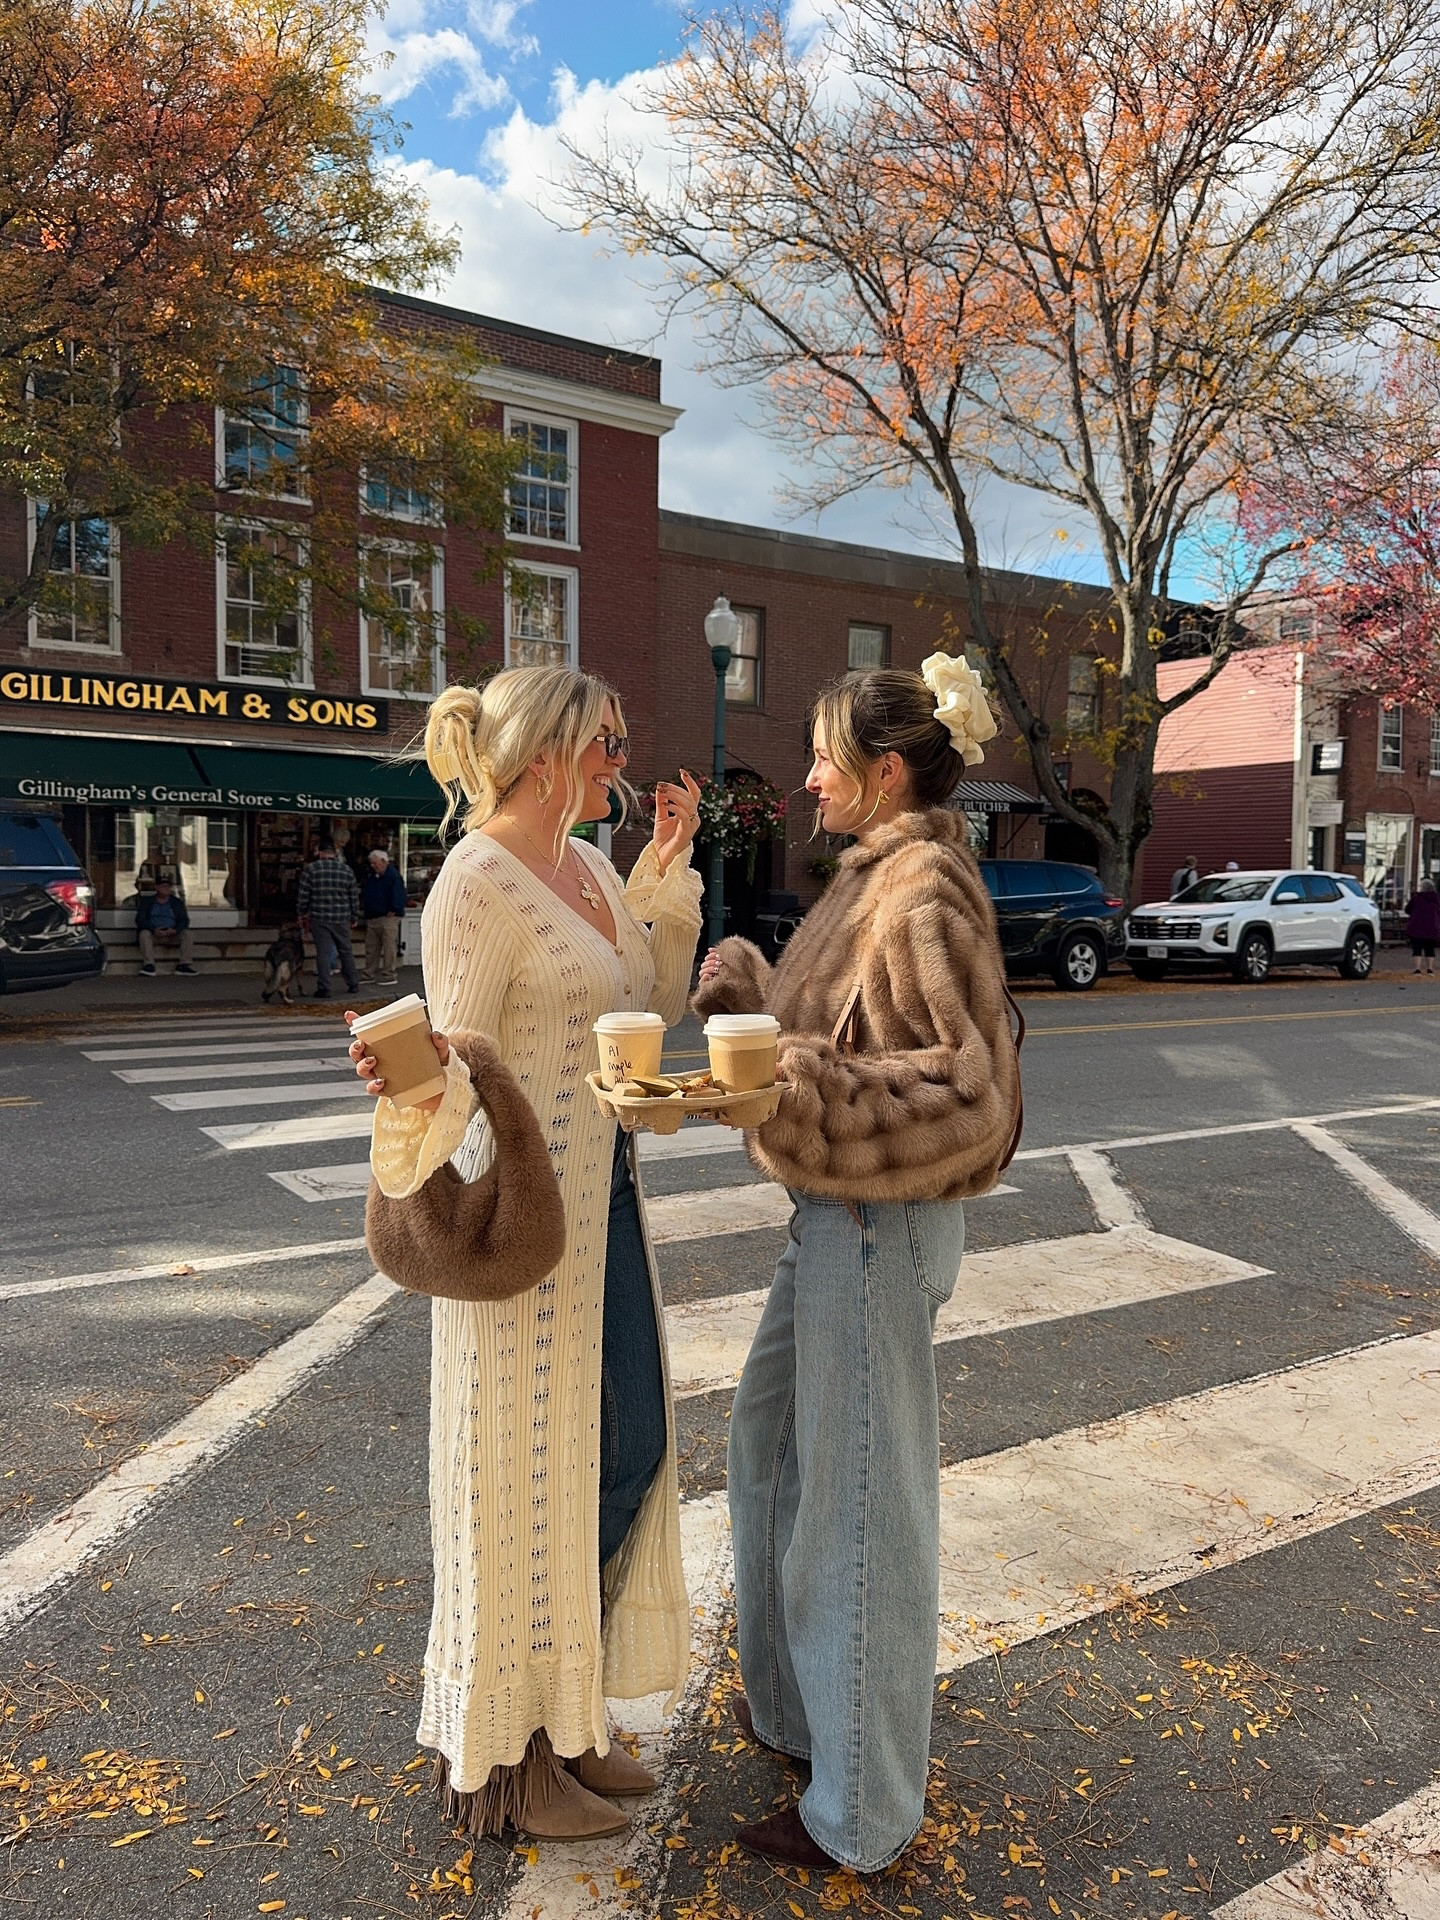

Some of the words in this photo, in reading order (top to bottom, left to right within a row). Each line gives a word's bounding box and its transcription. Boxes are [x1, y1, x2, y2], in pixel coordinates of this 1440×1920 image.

[1, 672, 229, 717] GILLINGHAM
[242, 693, 271, 719] &
[288, 697, 377, 728] SONS
[18, 779, 146, 803] Gillingham's
[151, 785, 222, 804] General
[228, 789, 273, 807] Store
[296, 793, 342, 811] Since
[347, 797, 380, 812] 1886
[964, 800, 1010, 813] BUTCHER
